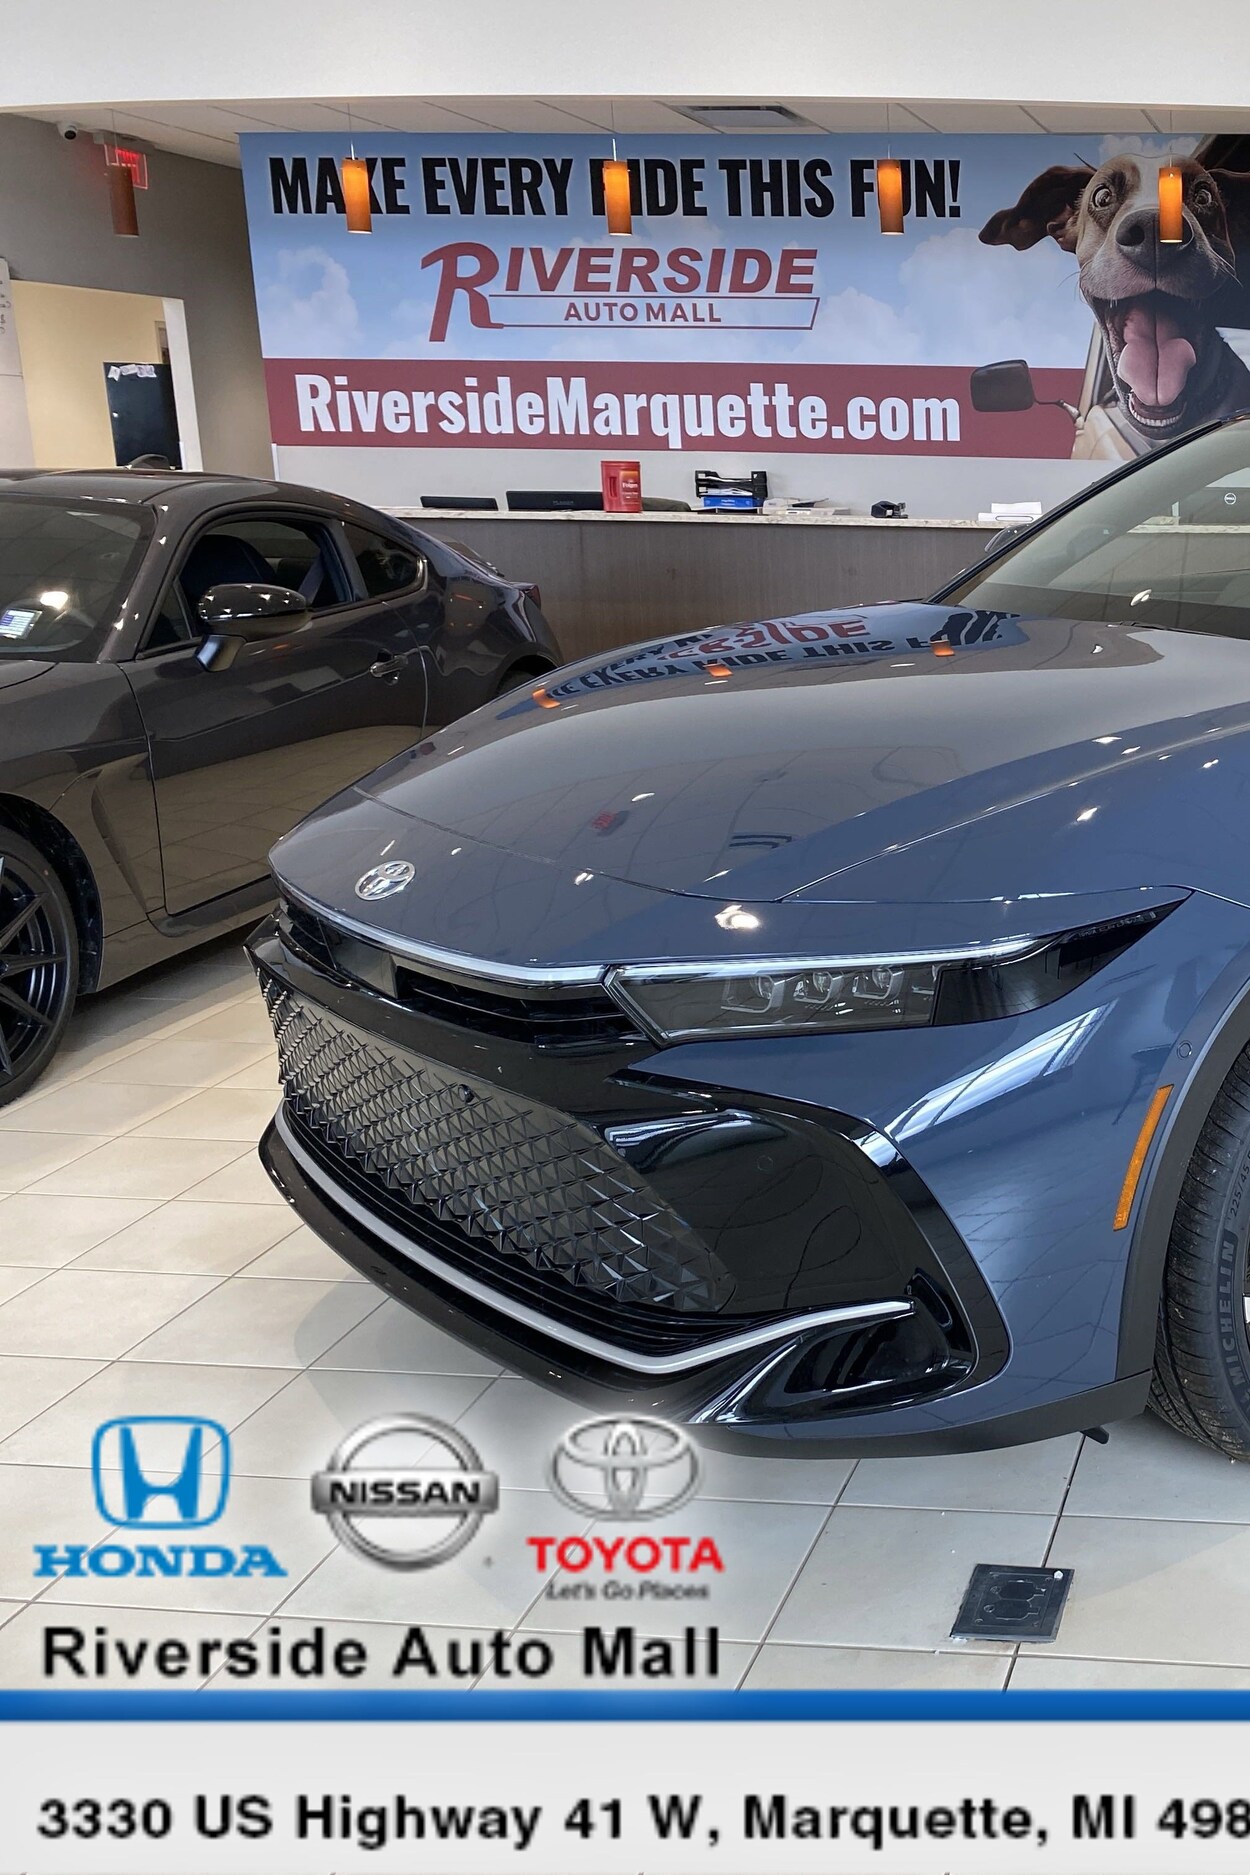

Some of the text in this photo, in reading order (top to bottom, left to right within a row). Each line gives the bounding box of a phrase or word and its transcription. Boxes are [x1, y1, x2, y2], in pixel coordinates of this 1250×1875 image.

[421, 157, 574, 217] EVERY
[718, 158, 835, 218] THIS
[420, 241, 818, 342] RIVERSIDE
[564, 302, 722, 323] AUTO MALL
[295, 374, 960, 450] RiversideMarquette.com
[1217, 1241, 1246, 1387] MICHELIN
